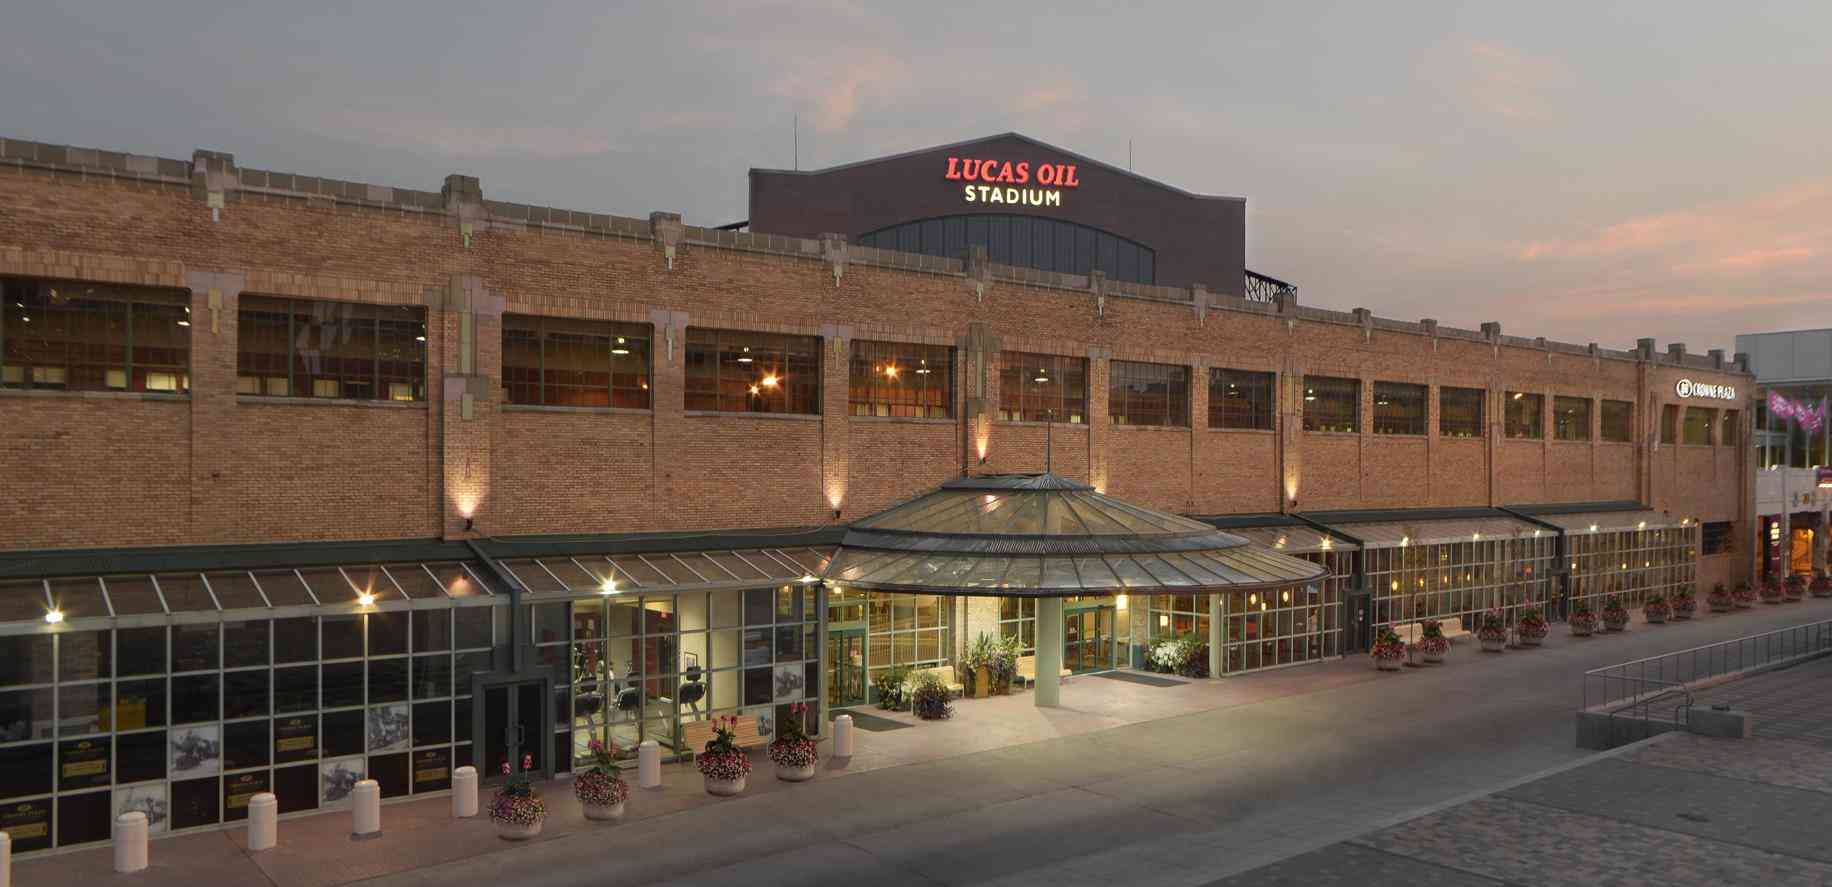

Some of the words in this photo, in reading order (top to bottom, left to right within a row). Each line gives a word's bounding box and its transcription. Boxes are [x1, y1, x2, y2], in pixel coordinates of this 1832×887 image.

[945, 157, 1030, 183] LUCAS
[1037, 163, 1079, 186] OIL
[965, 186, 1060, 206] STADIUM
